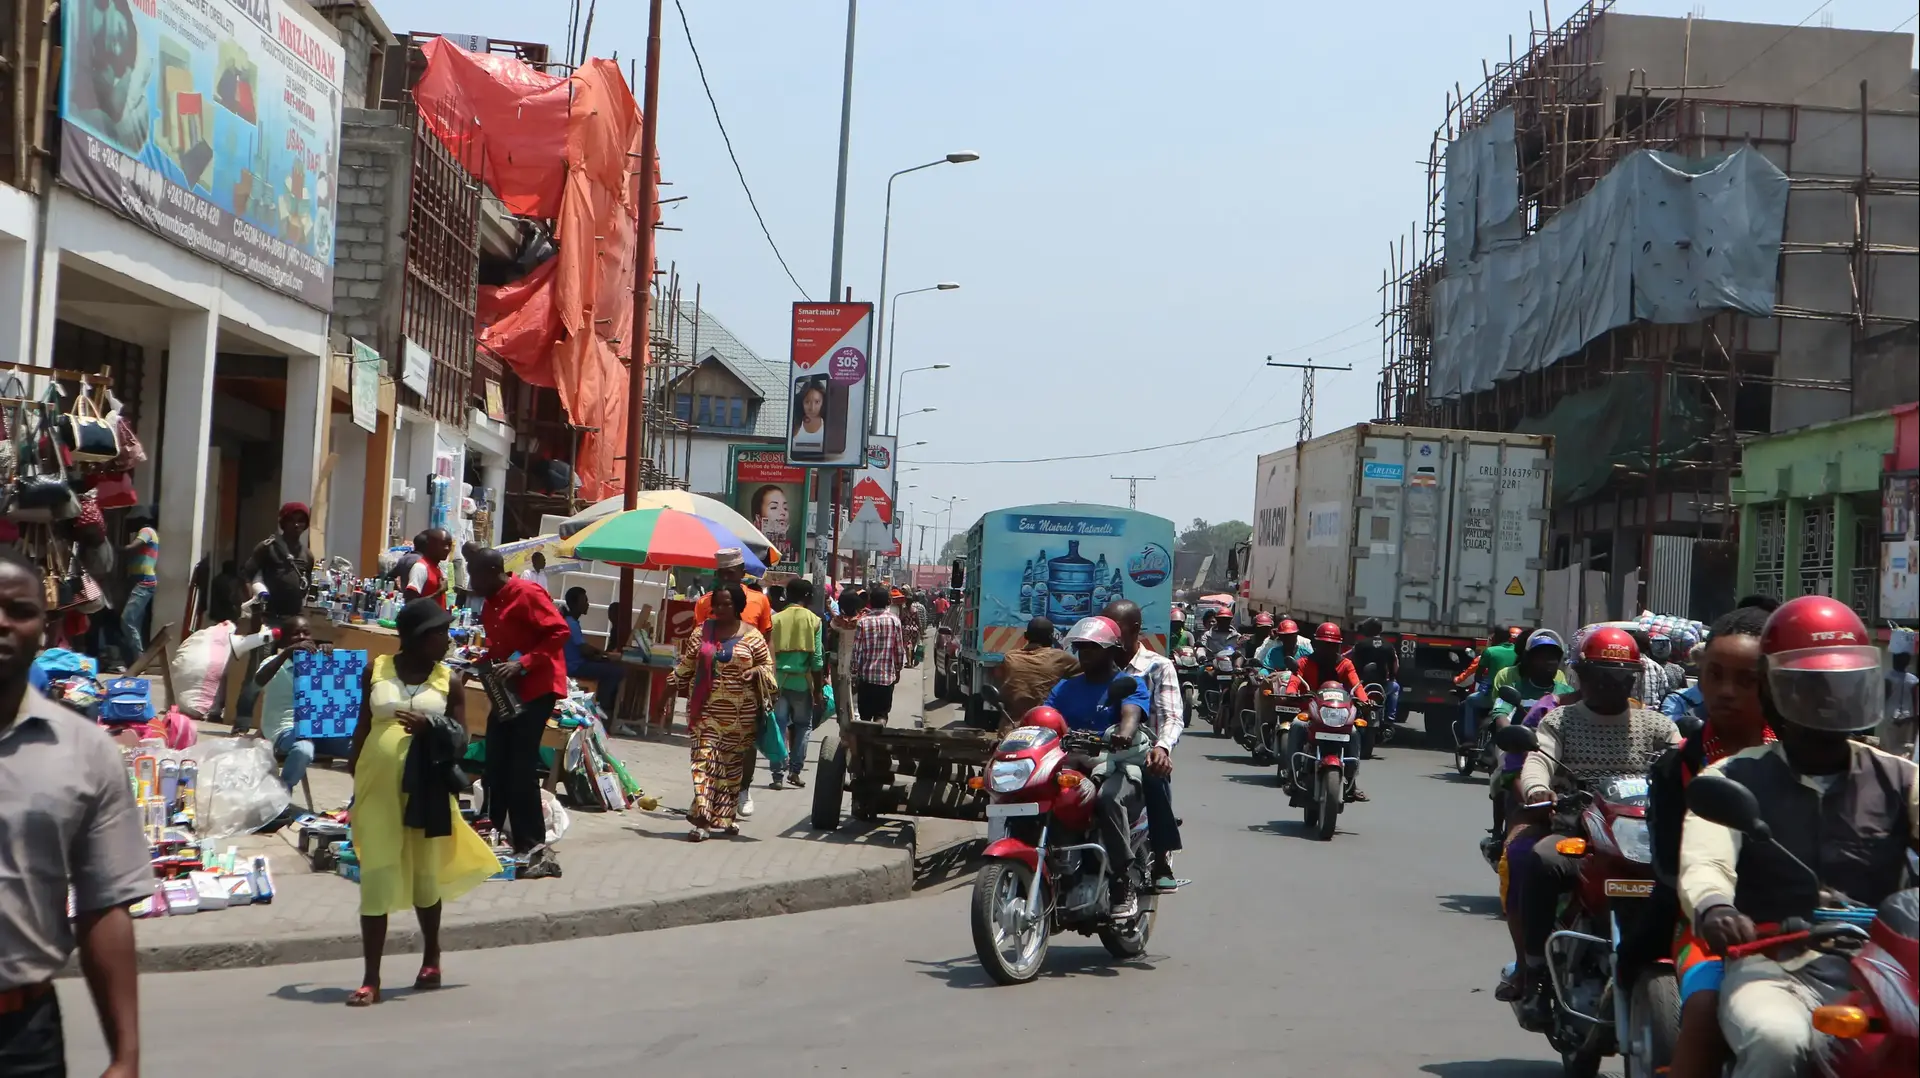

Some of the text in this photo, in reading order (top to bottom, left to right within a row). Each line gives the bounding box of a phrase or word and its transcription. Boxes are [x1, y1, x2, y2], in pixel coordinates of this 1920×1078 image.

[278, 12, 335, 83] MBIZAFOAM
[101, 151, 119, 173] +243
[167, 188, 183, 208] +243
[184, 192, 196, 215] 972
[196, 200, 208, 218] 454
[798, 308, 841, 316] Smart mini 7
[837, 355, 859, 370] 30$
[1365, 464, 1401, 475] CARLISLE
[1480, 466, 1540, 479] CRLU 316379 0
[1019, 518, 1113, 534] Eau Minérale Naturelle
[1812, 632, 1835, 641] TVS
[1401, 640, 1416, 653] 80
[485, 674, 509, 718] Hennessy
[1608, 883, 1654, 893] PHILADE
